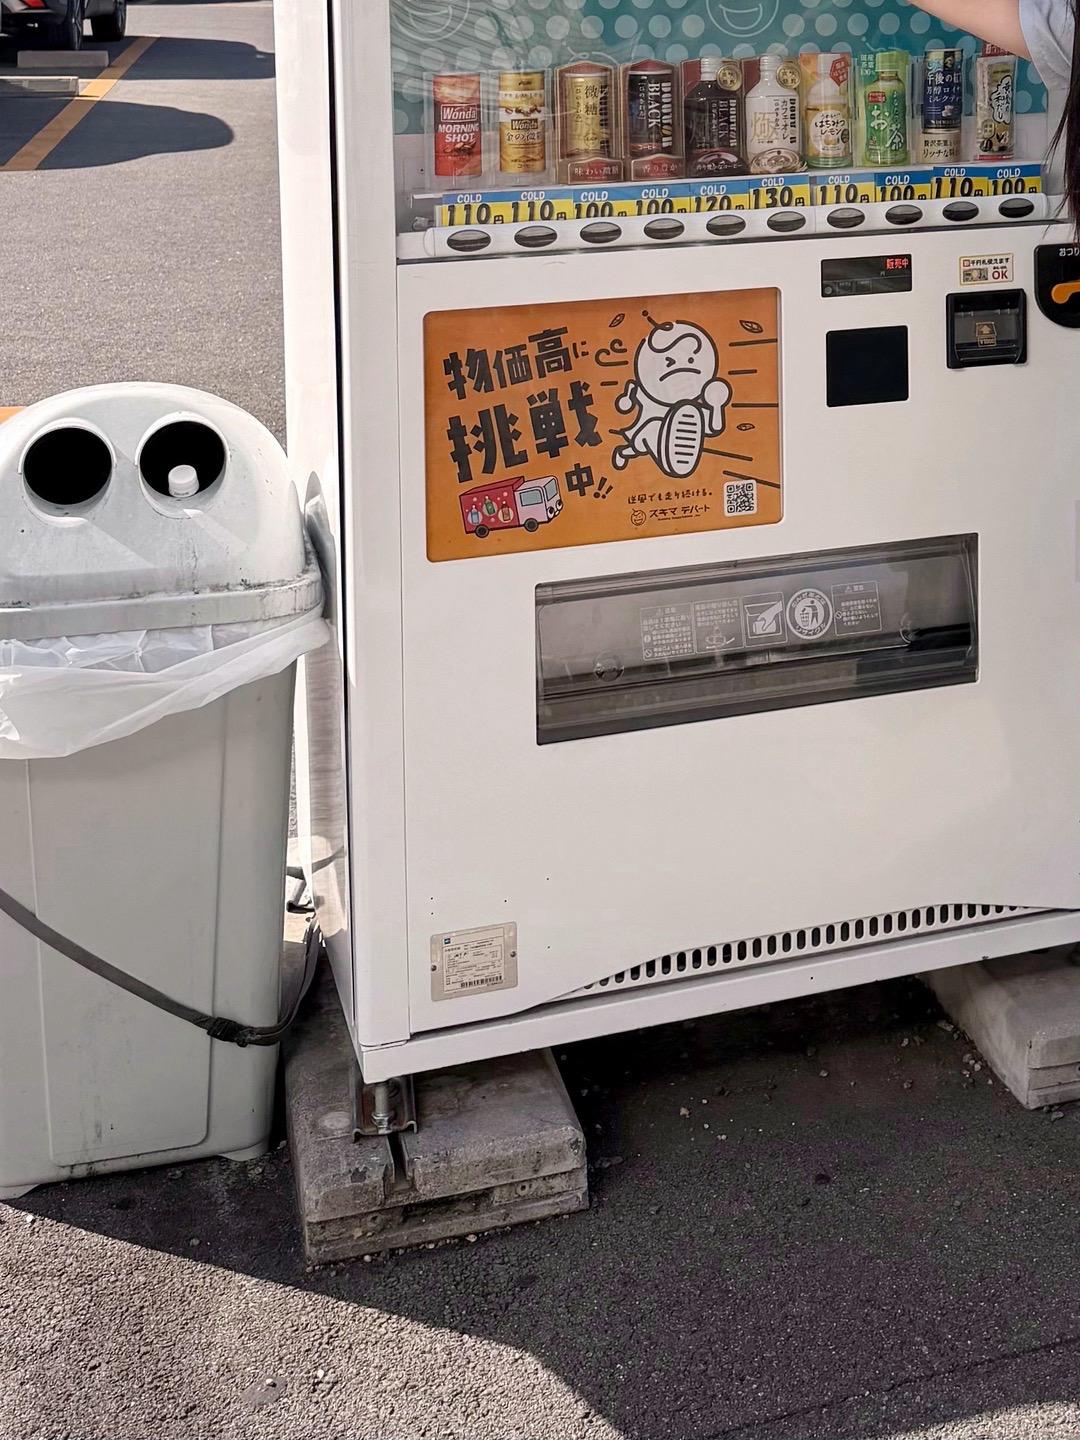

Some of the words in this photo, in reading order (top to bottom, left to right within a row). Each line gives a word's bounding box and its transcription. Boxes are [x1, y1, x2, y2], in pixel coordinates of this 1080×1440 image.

[647, 83, 661, 128] BLACK
[443, 106, 476, 120] Wonda
[719, 100, 729, 138] BLACK
[814, 120, 846, 128] はちみつ
[438, 123, 479, 133] MORNING
[820, 128, 842, 136] レモン
[445, 133, 475, 143] SHOT
[944, 167, 966, 177] COLD
[997, 168, 1021, 179] COLD
[761, 177, 785, 187] COLD
[828, 175, 851, 185] COLD
[885, 175, 910, 186] COLD
[520, 191, 545, 201] COLD
[641, 188, 669, 199] COLD
[700, 185, 727, 196] COLD
[820, 184, 869, 205] 110円
[457, 193, 482, 203] COLD
[581, 191, 608, 202] COLD
[752, 187, 805, 209] 130円
[448, 203, 504, 226] 110円
[511, 200, 567, 224] 110円
[886, 257, 909, 270] 販売中
[991, 270, 1009, 281] OK
[443, 326, 589, 400] 物価高に
[446, 380, 603, 483] 挑戦
[649, 507, 678, 518] スキマ
[681, 504, 710, 515] デパート
